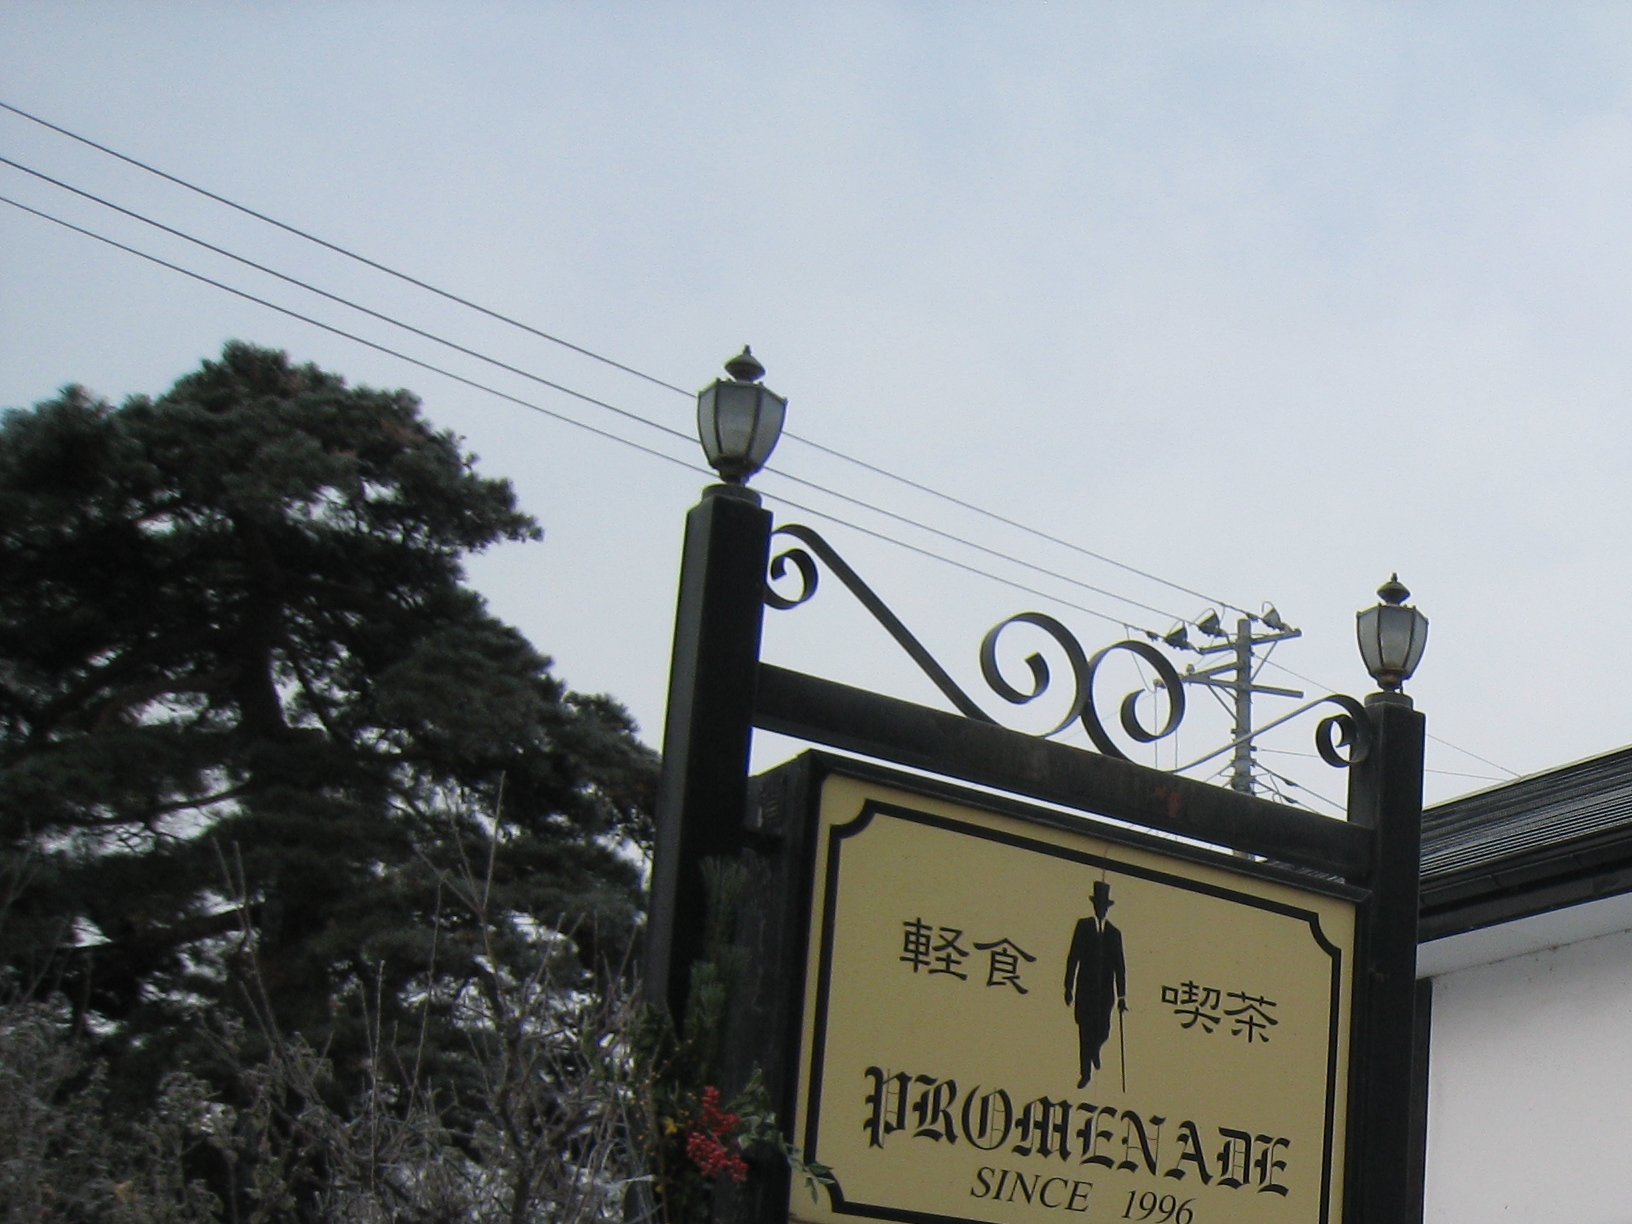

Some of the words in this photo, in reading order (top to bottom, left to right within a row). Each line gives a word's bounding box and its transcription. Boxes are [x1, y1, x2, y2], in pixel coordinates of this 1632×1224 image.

[899, 916, 1037, 995] 軽食
[1161, 981, 1278, 1043] 喫茶
[863, 1066, 1290, 1197] PROMENADE
[970, 1166, 1093, 1213] SINCE
